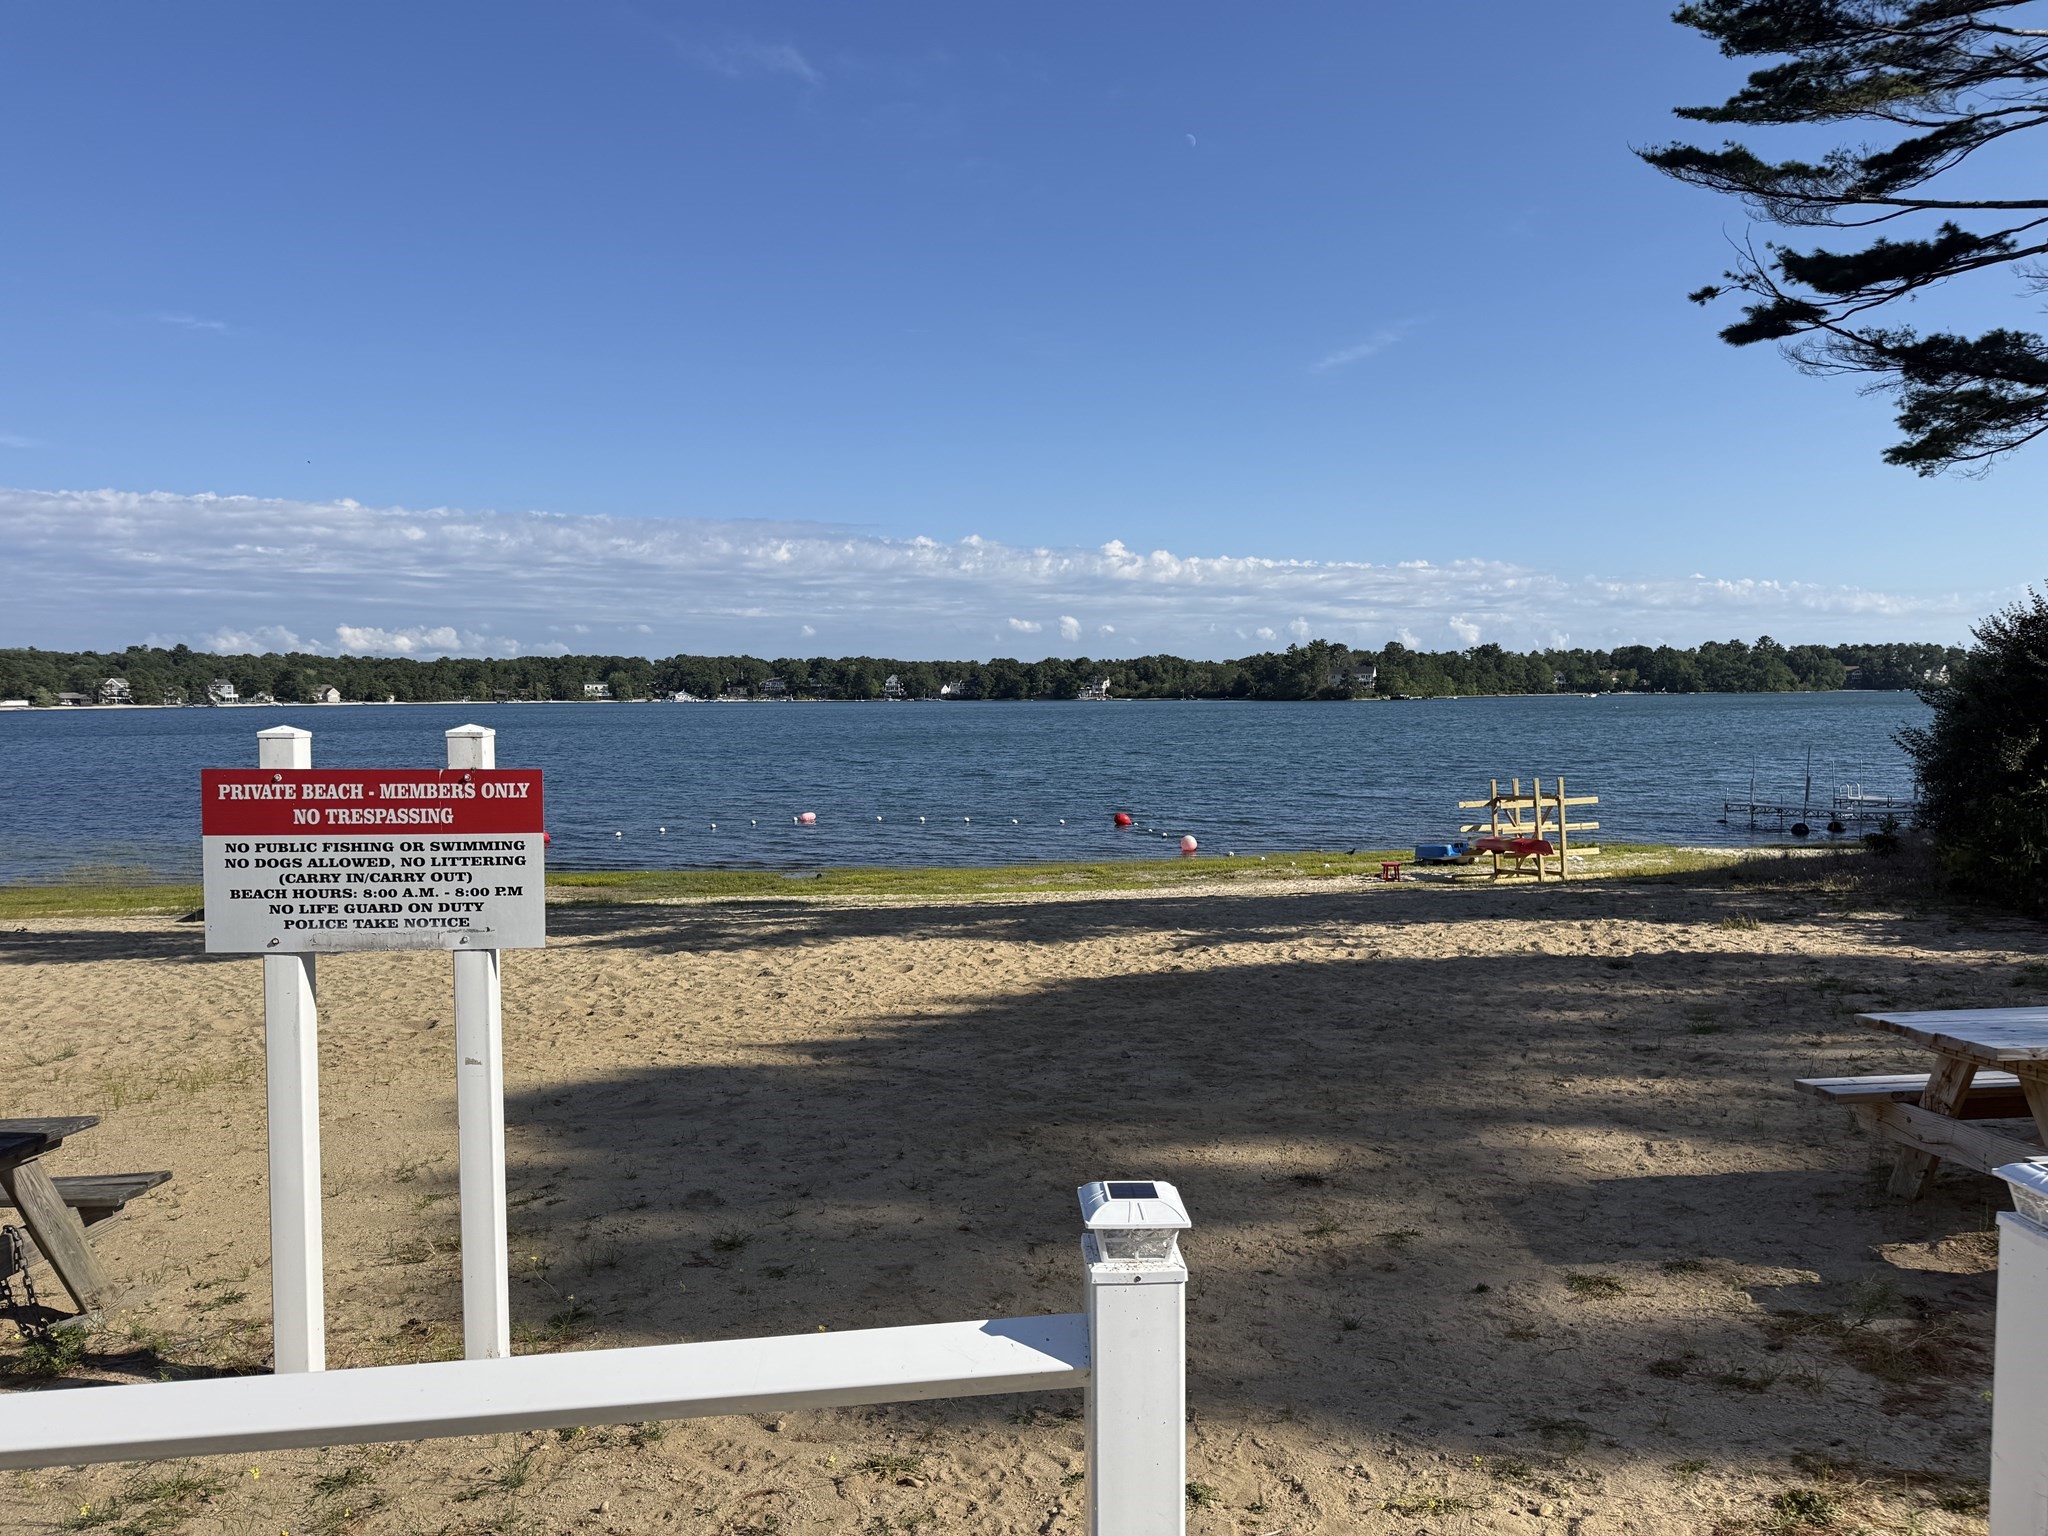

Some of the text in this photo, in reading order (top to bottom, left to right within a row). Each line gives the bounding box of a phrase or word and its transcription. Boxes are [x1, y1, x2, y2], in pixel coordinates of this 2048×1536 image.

[218, 783, 296, 800] PRIVATE
[301, 783, 363, 800] BEACH
[380, 783, 475, 799] MEMBERS
[481, 782, 530, 799] ONLY
[293, 808, 453, 825] NO TRESPASSING
[225, 841, 526, 853] NO PUBLIC FISHING OR SWIMMING
[225, 856, 526, 870] NO DOGS ALLOWED, NO LITTERING
[279, 871, 473, 886] (CARRY IN/CARRY OUT)
[230, 889, 288, 899] BEACH
[293, 888, 358, 899] HOURS:
[363, 888, 397, 899] 8:00
[402, 887, 439, 898] A.M.
[455, 887, 489, 898] 8:00
[495, 886, 523, 897] P.M
[269, 902, 485, 915] NO LIFE GUARD ON DUTY
[284, 917, 470, 930] POLICE TAKE NOTICE
